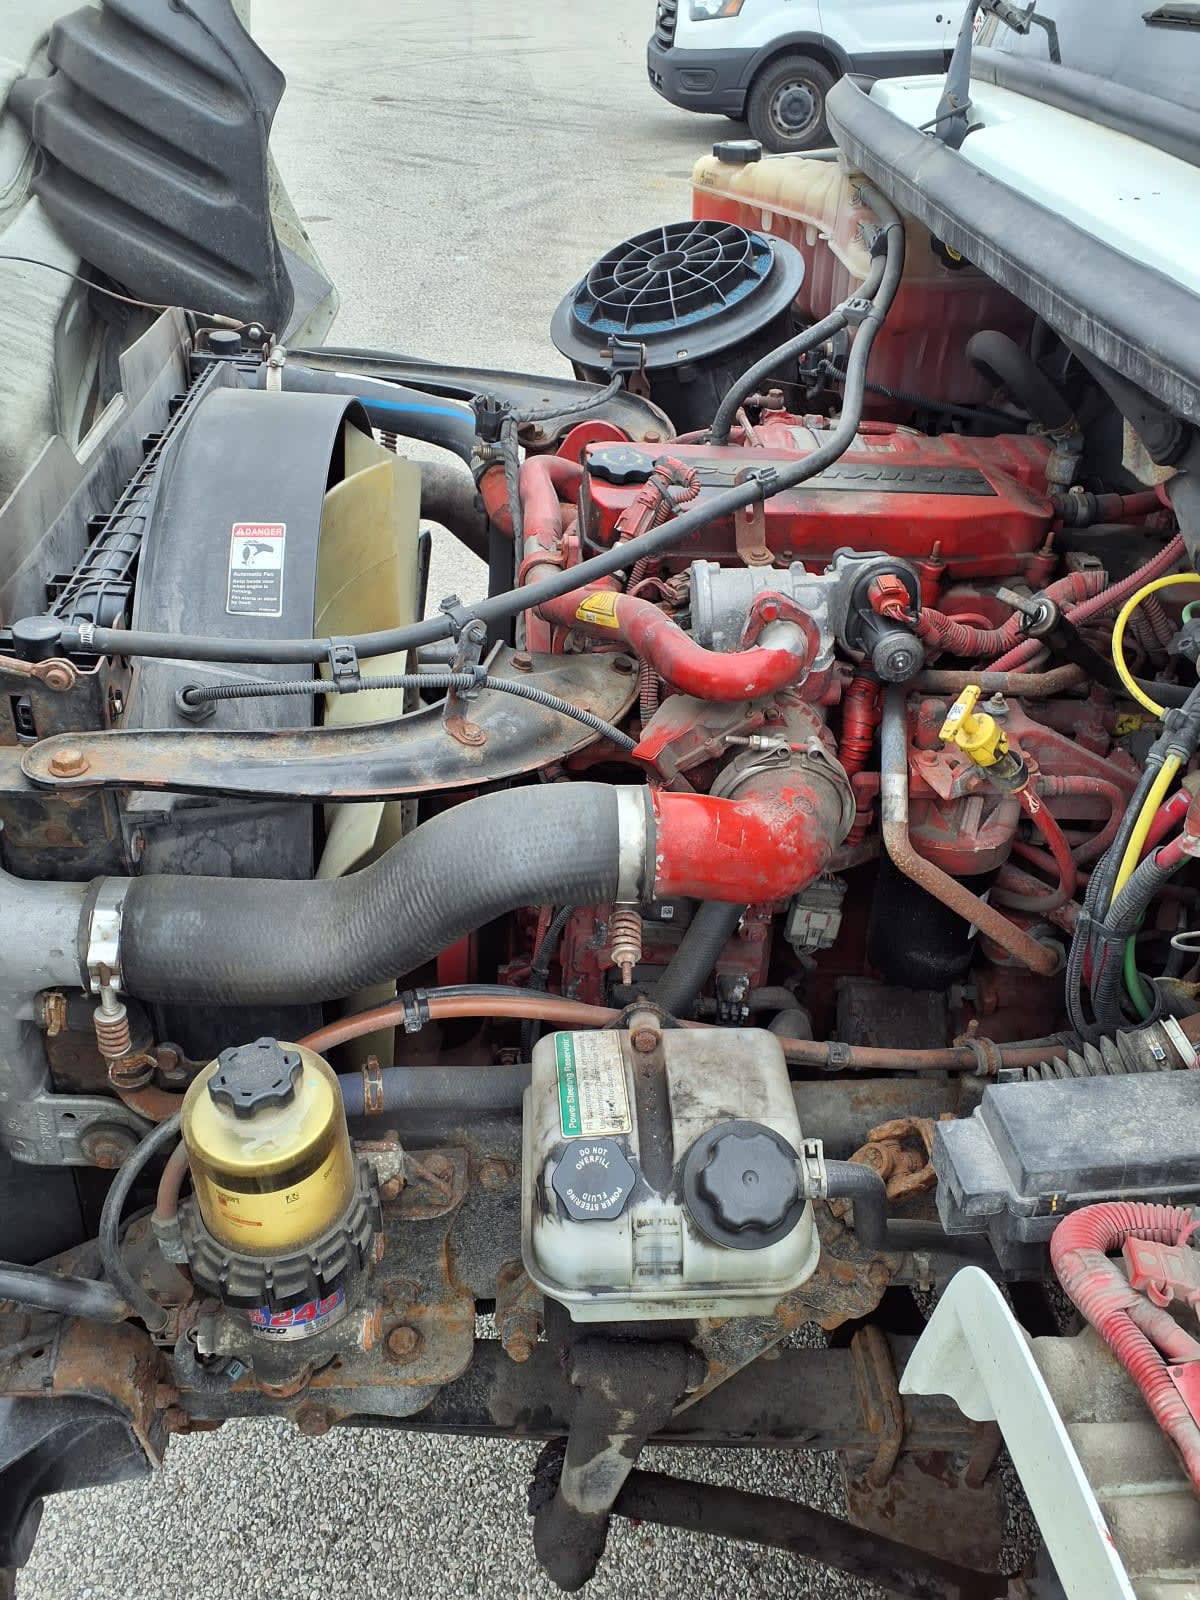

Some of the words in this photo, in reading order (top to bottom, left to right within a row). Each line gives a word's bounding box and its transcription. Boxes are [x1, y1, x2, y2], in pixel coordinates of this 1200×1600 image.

[245, 527, 282, 536] DANGER
[561, 1039, 572, 1072] Reservoir
[566, 1072, 575, 1104] Steering
[568, 1105, 577, 1129] Power
[575, 1155, 611, 1170] OVERFILL
[579, 1147, 590, 1157] DO
[592, 1146, 608, 1156] NOT
[566, 1188, 599, 1211] STEERING
[582, 1191, 608, 1202] FLUID
[601, 1186, 623, 1209] POWER
